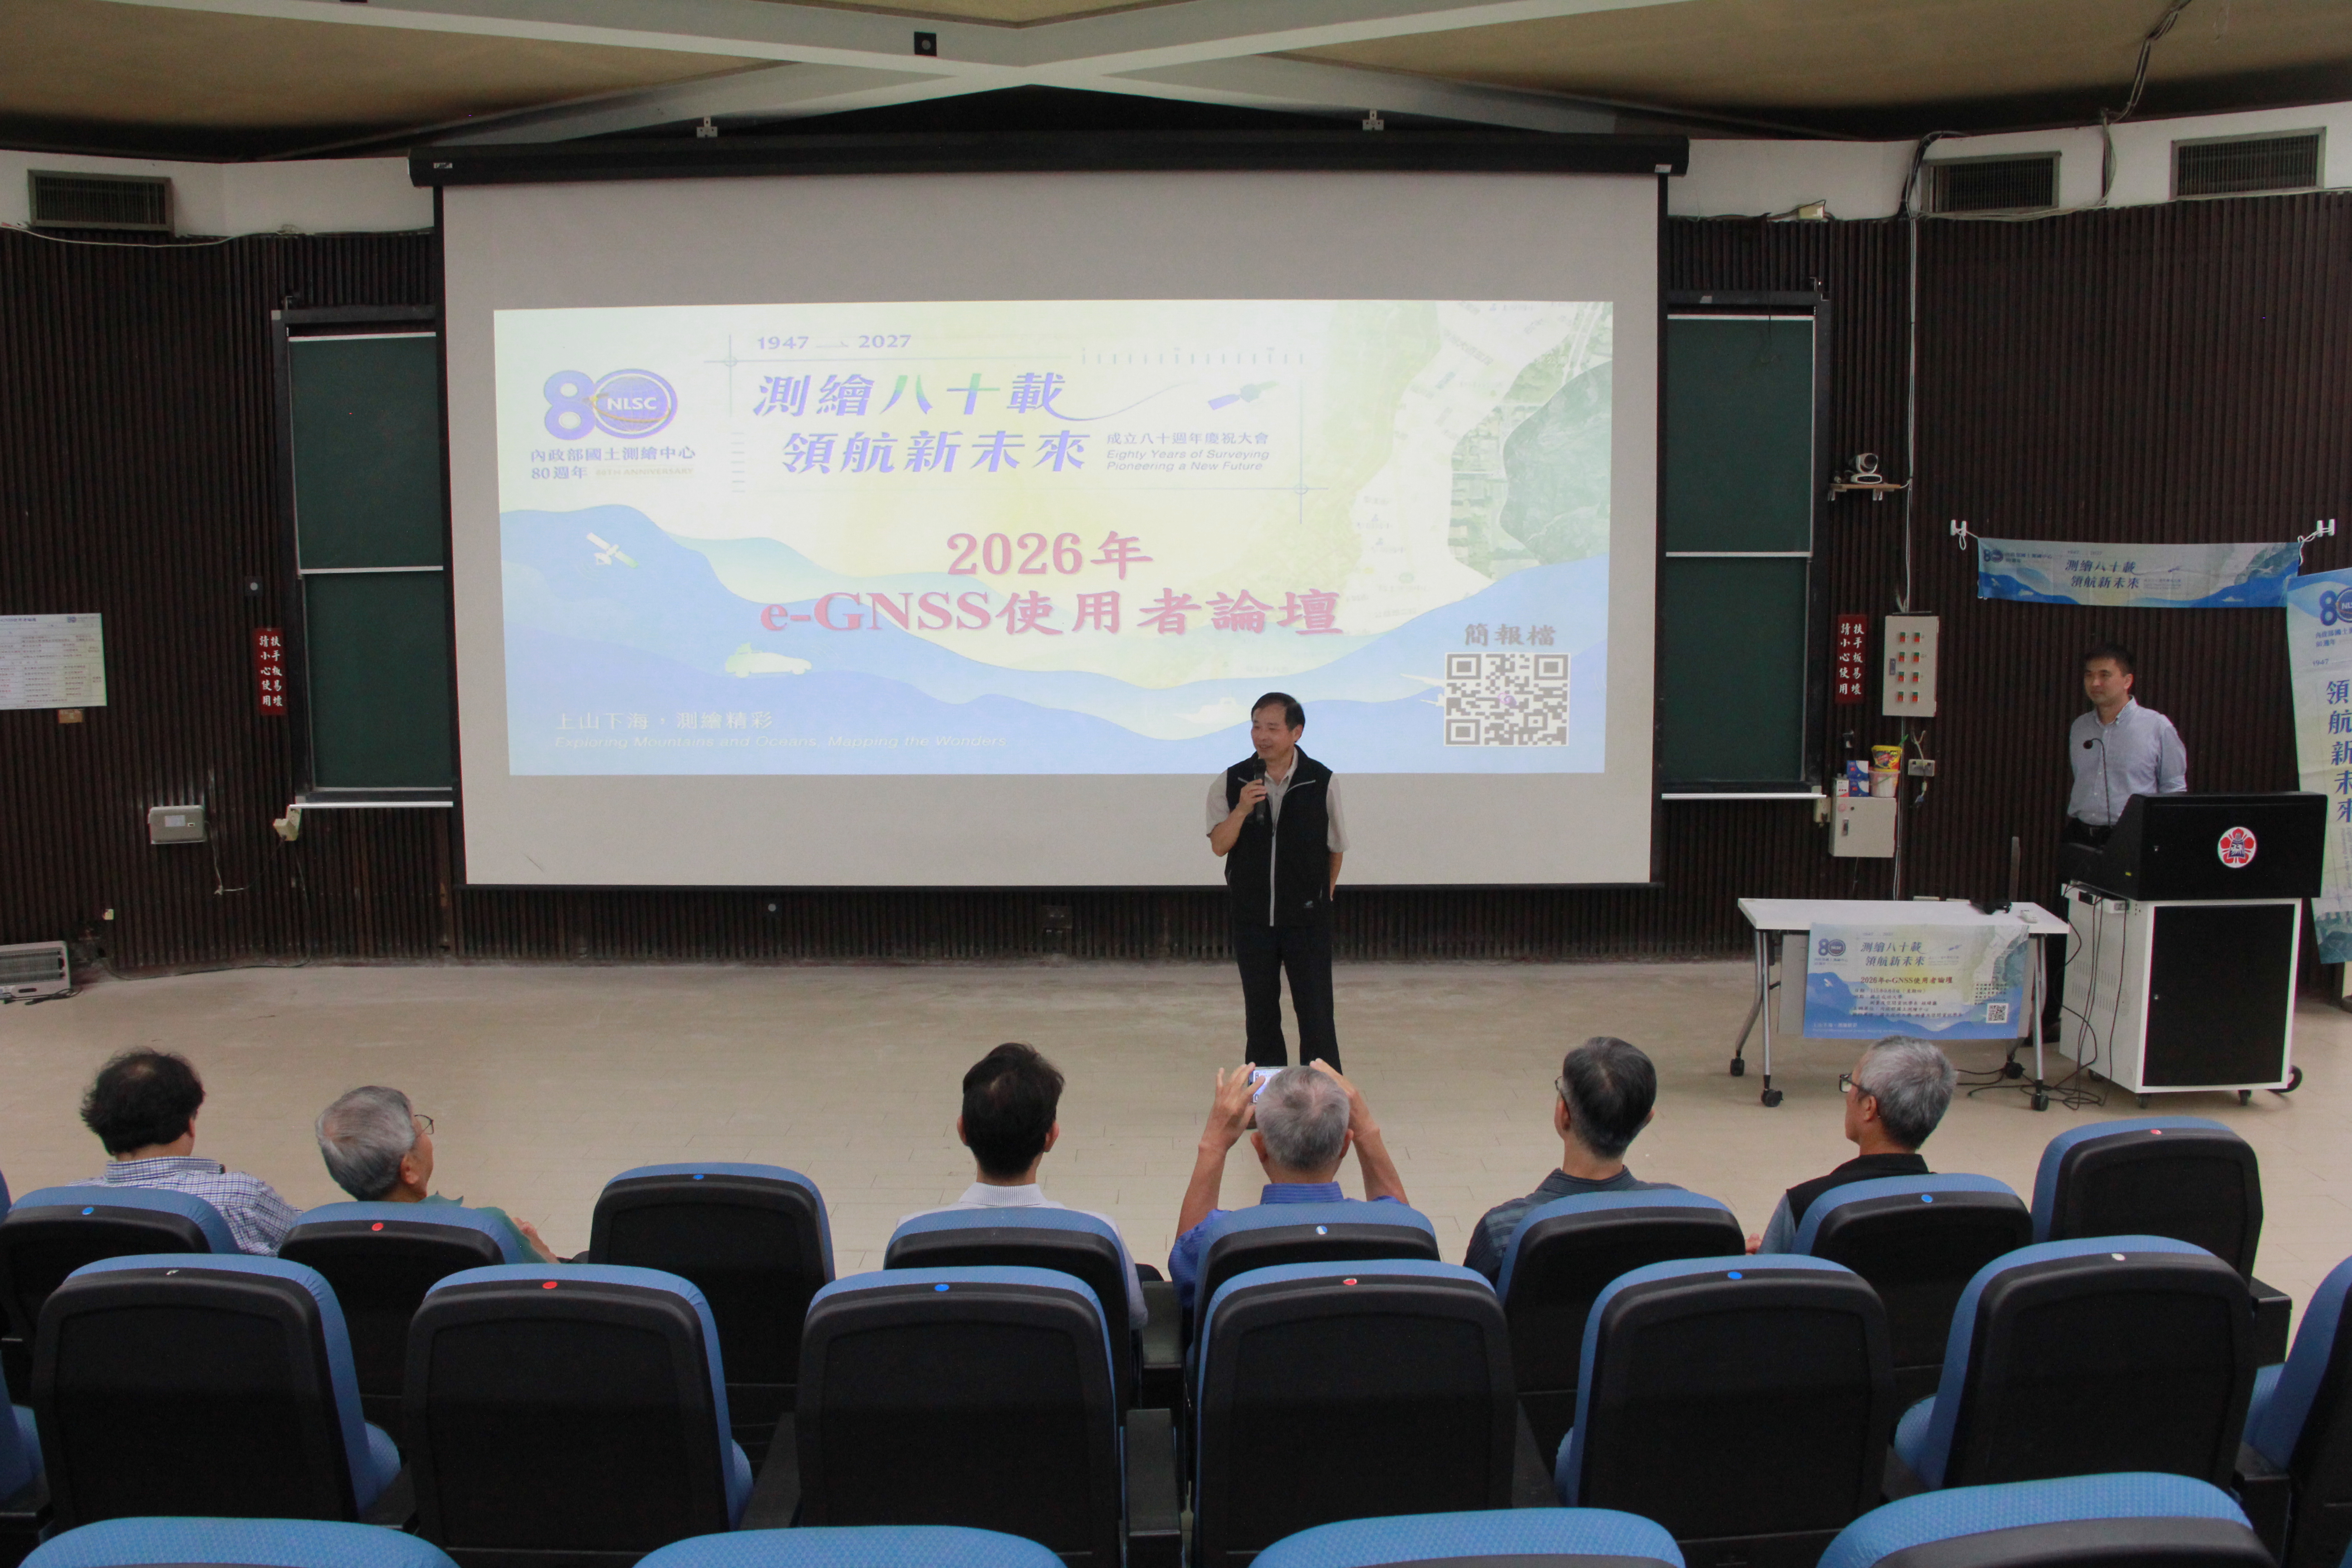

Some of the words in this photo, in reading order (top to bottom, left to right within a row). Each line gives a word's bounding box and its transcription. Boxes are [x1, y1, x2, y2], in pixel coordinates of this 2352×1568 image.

[757, 336, 809, 350] 1947
[858, 334, 912, 349] 2027
[753, 372, 1066, 418] 測繪八十載
[607, 396, 657, 411] NLSC
[1107, 432, 1269, 445] 成立八十週年慶祝大會
[531, 446, 696, 463] 內政部國土測繪中心
[782, 430, 1090, 475] 領航新未來
[1107, 450, 1146, 460] Eighty
[1151, 450, 1186, 459] Years
[1191, 450, 1203, 459] of
[1207, 450, 1269, 461] Surveying
[531, 466, 588, 480] 80週年
[623, 468, 694, 476] ANNIVERSARY
[1107, 461, 1174, 472] Pioneering
[1191, 461, 1218, 470] New
[1222, 461, 1263, 470] Future
[946, 529, 1155, 581] 2026年
[2065, 559, 2137, 573] 測繪八十載
[2071, 576, 2141, 589] 領航新未來
[760, 587, 1344, 637] e-GNSS使用者論壇
[1464, 623, 1556, 647] 簡報檔
[1839, 622, 1851, 695] 請小心使用
[555, 711, 773, 730] 上山下海，測繪精彩
[555, 737, 628, 750] Exploring
[633, 736, 715, 747] Mountains
[720, 736, 751, 747] and
[828, 736, 899, 749] Mapping
[904, 736, 930, 747] the
[936, 736, 1007, 747] Wonders
[1861, 941, 1923, 953] 測繪八十載
[1865, 956, 1926, 967] 領航新未來
